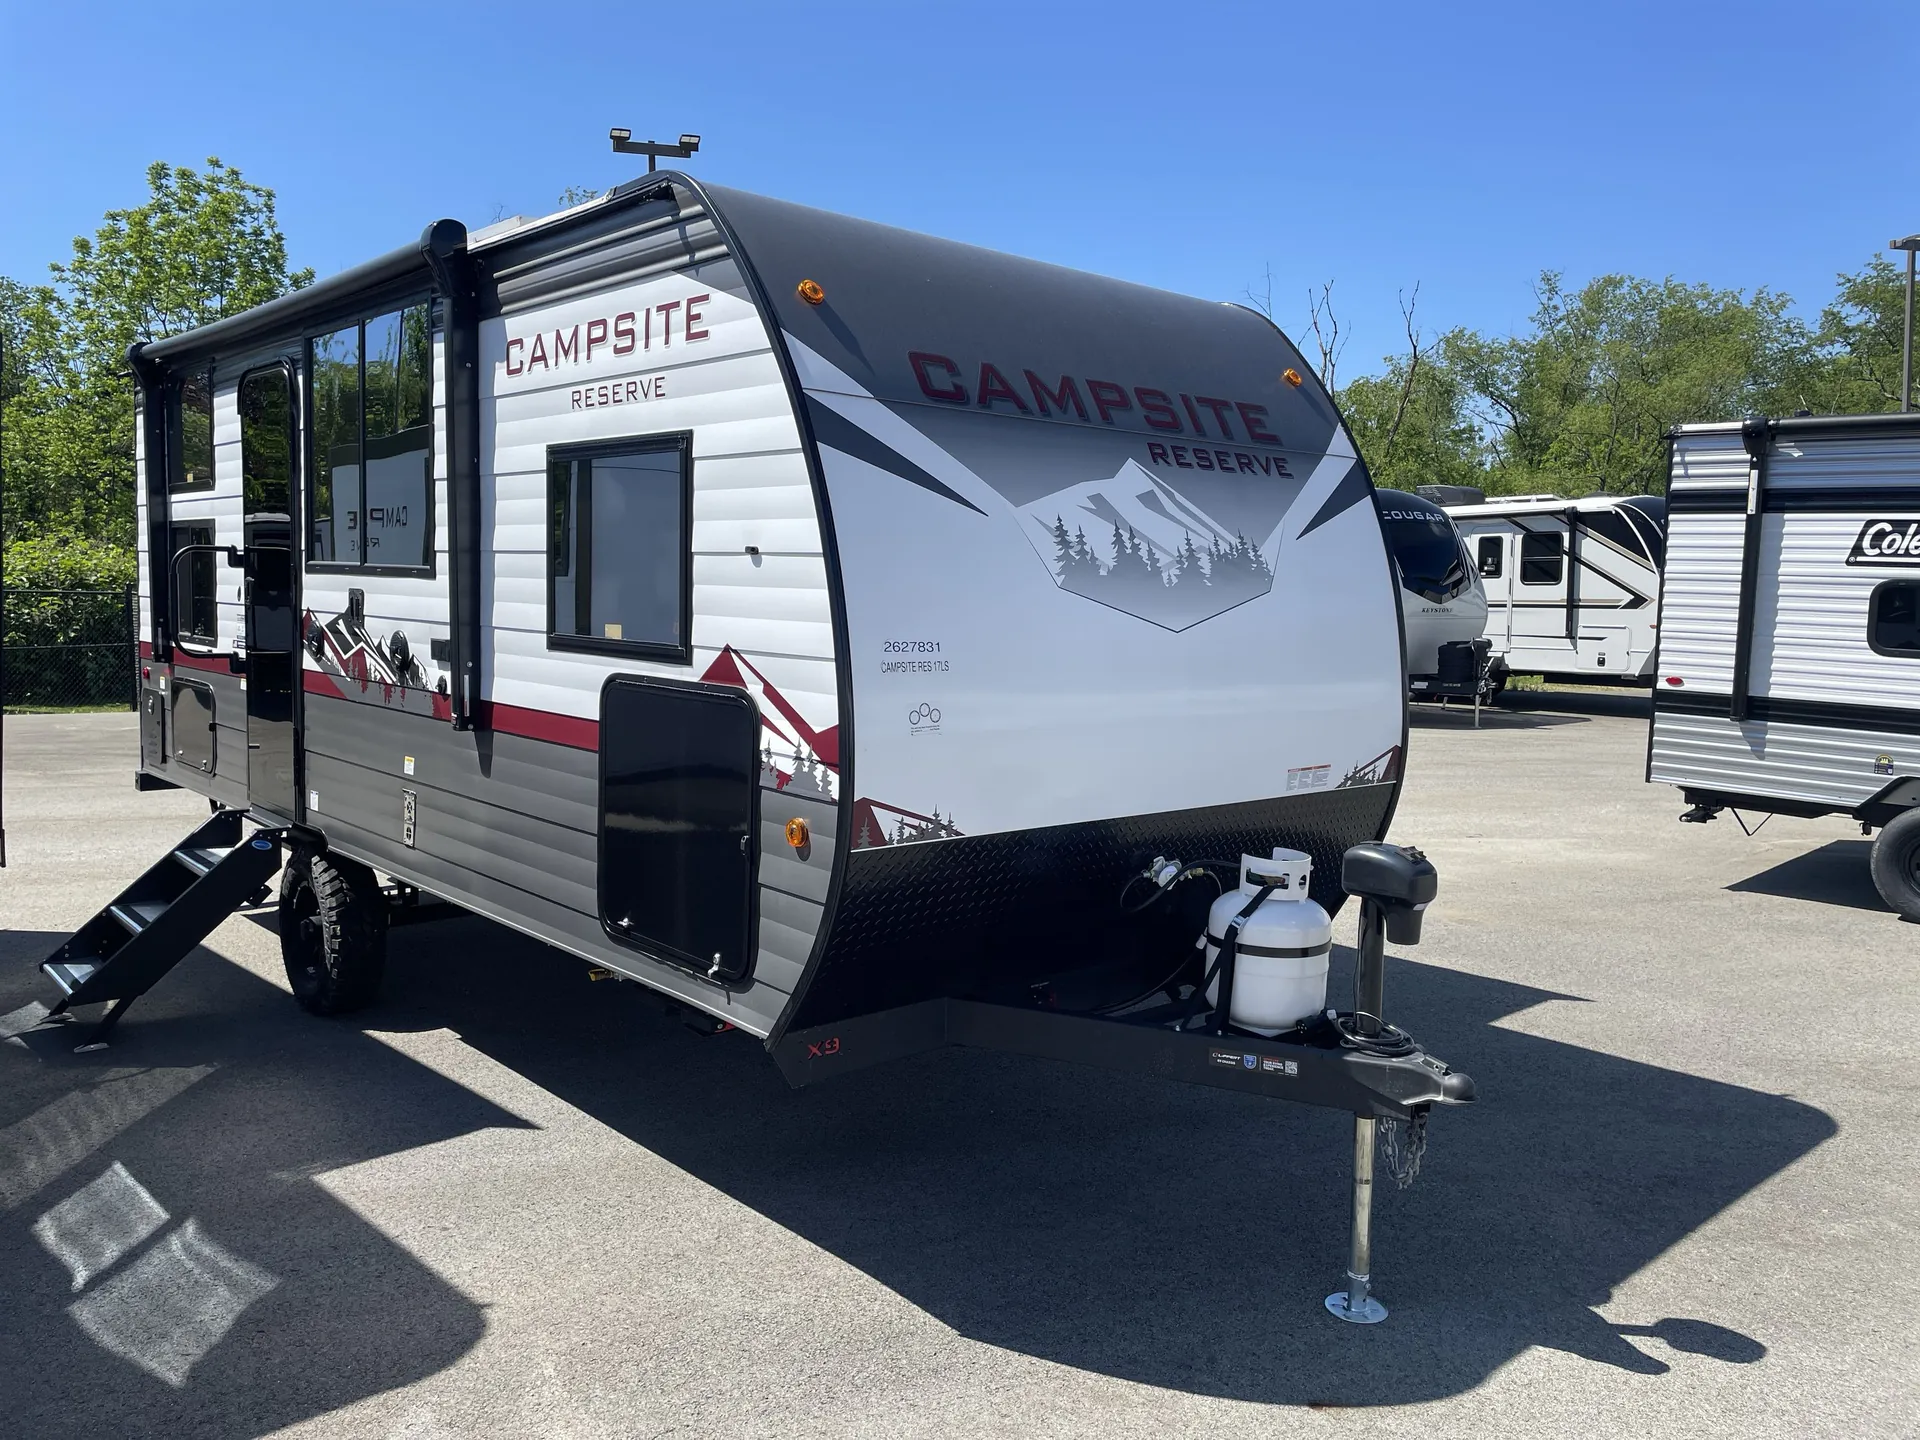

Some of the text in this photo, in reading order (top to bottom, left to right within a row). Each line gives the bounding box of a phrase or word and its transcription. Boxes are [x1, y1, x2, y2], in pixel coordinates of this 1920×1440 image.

[505, 292, 711, 377] CAMPSITE
[571, 376, 666, 410] RESERVE
[908, 350, 1282, 445] CAMPSITE
[1147, 442, 1294, 479] RESERVE
[883, 641, 941, 653] 2627831
[881, 660, 950, 673] CAMPSITE RES 17LS
